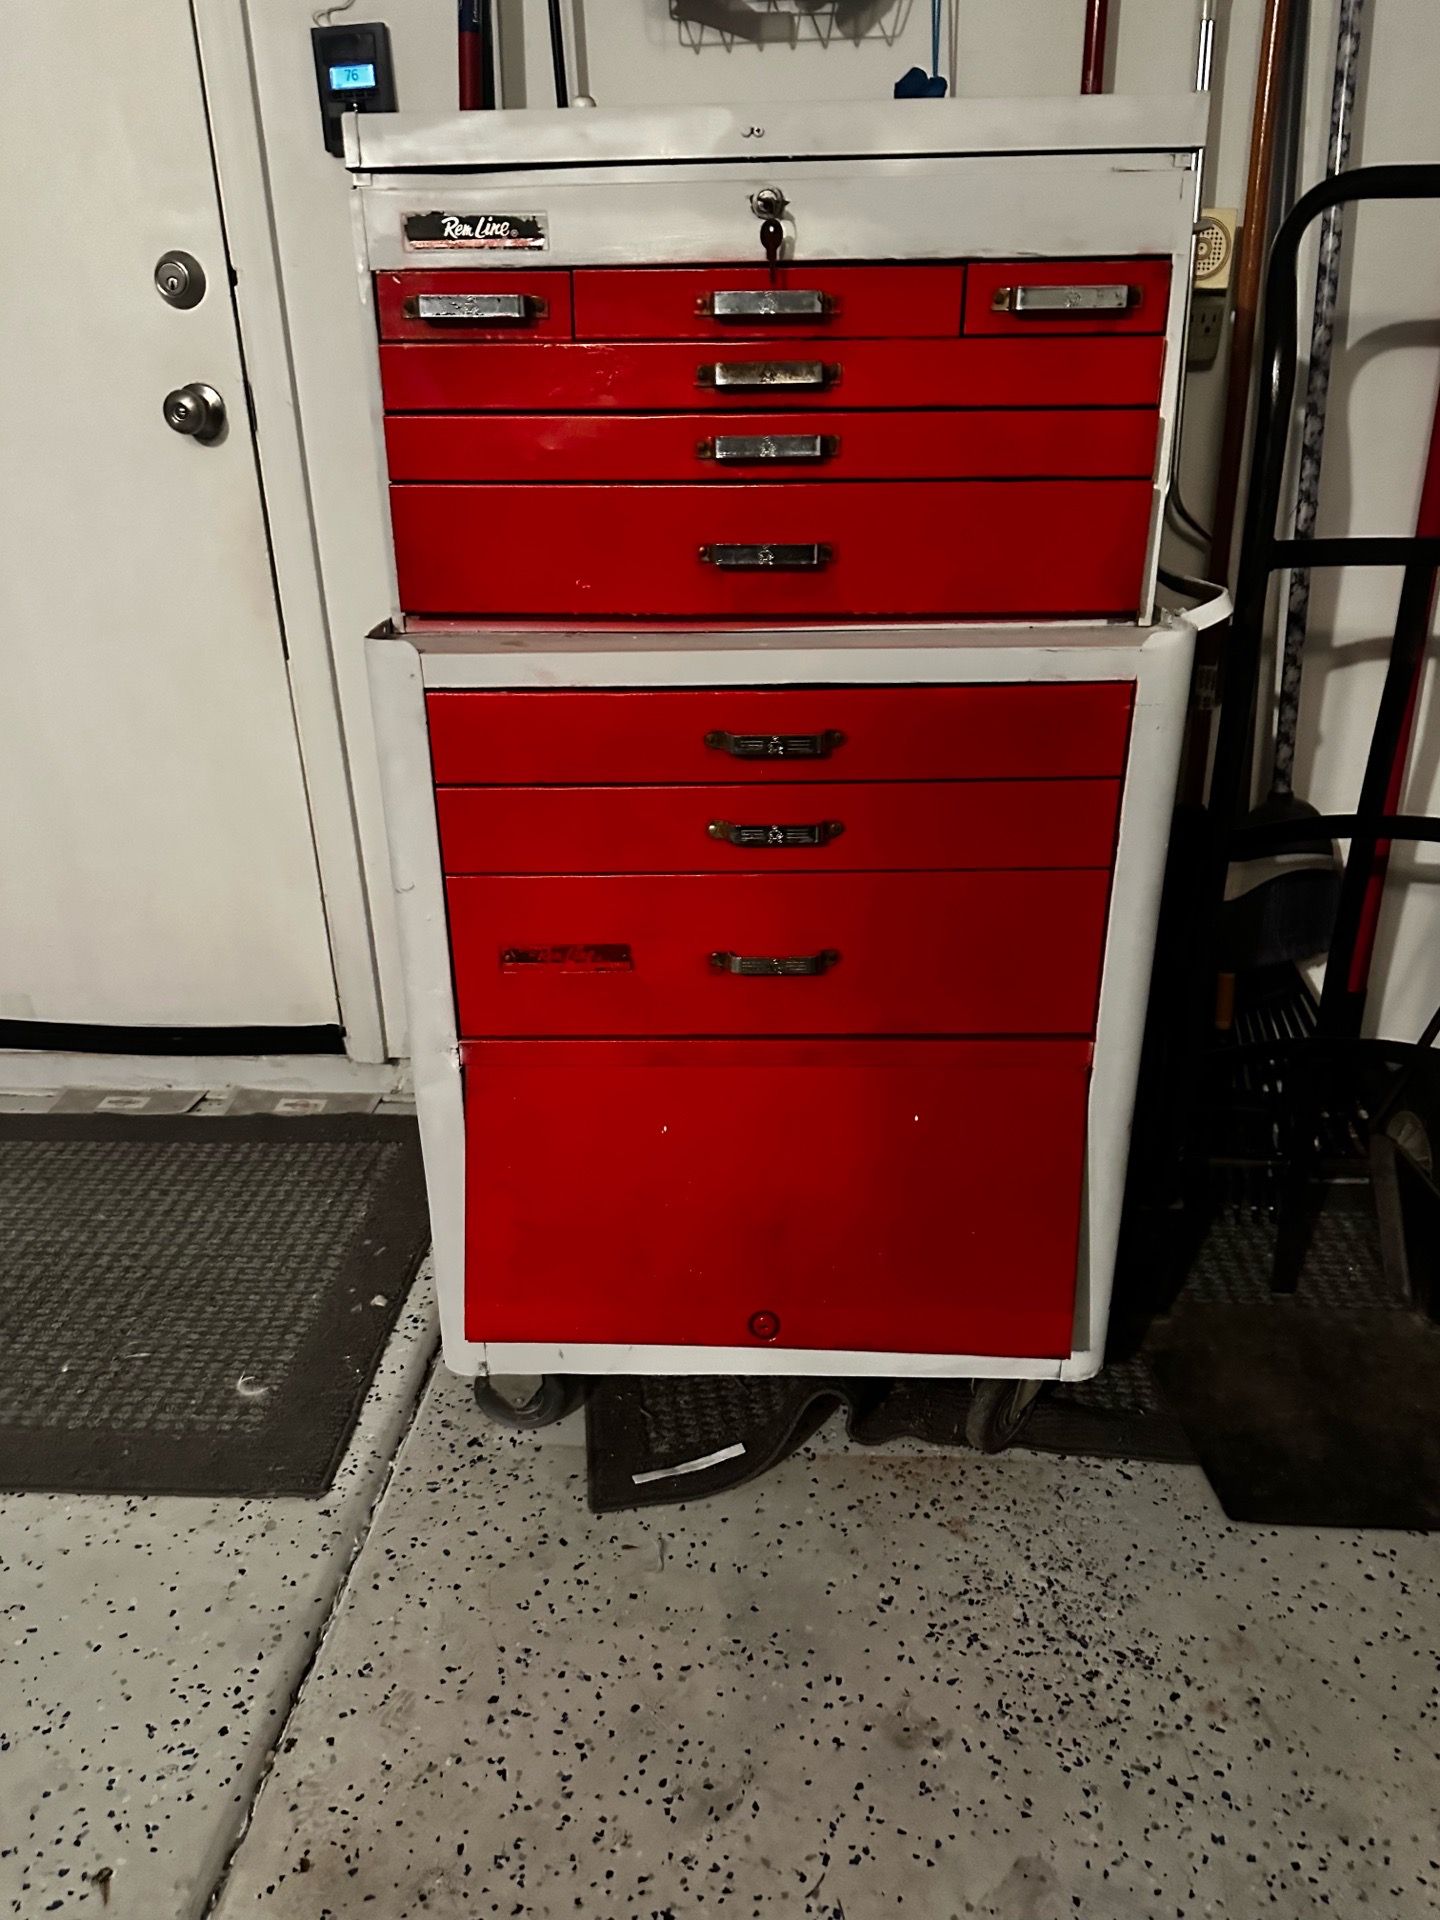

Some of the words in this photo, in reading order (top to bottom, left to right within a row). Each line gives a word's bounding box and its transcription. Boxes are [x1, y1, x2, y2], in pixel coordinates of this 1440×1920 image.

[344, 69, 359, 82] 76
[441, 216, 474, 239] Rem
[474, 215, 510, 239] Line
